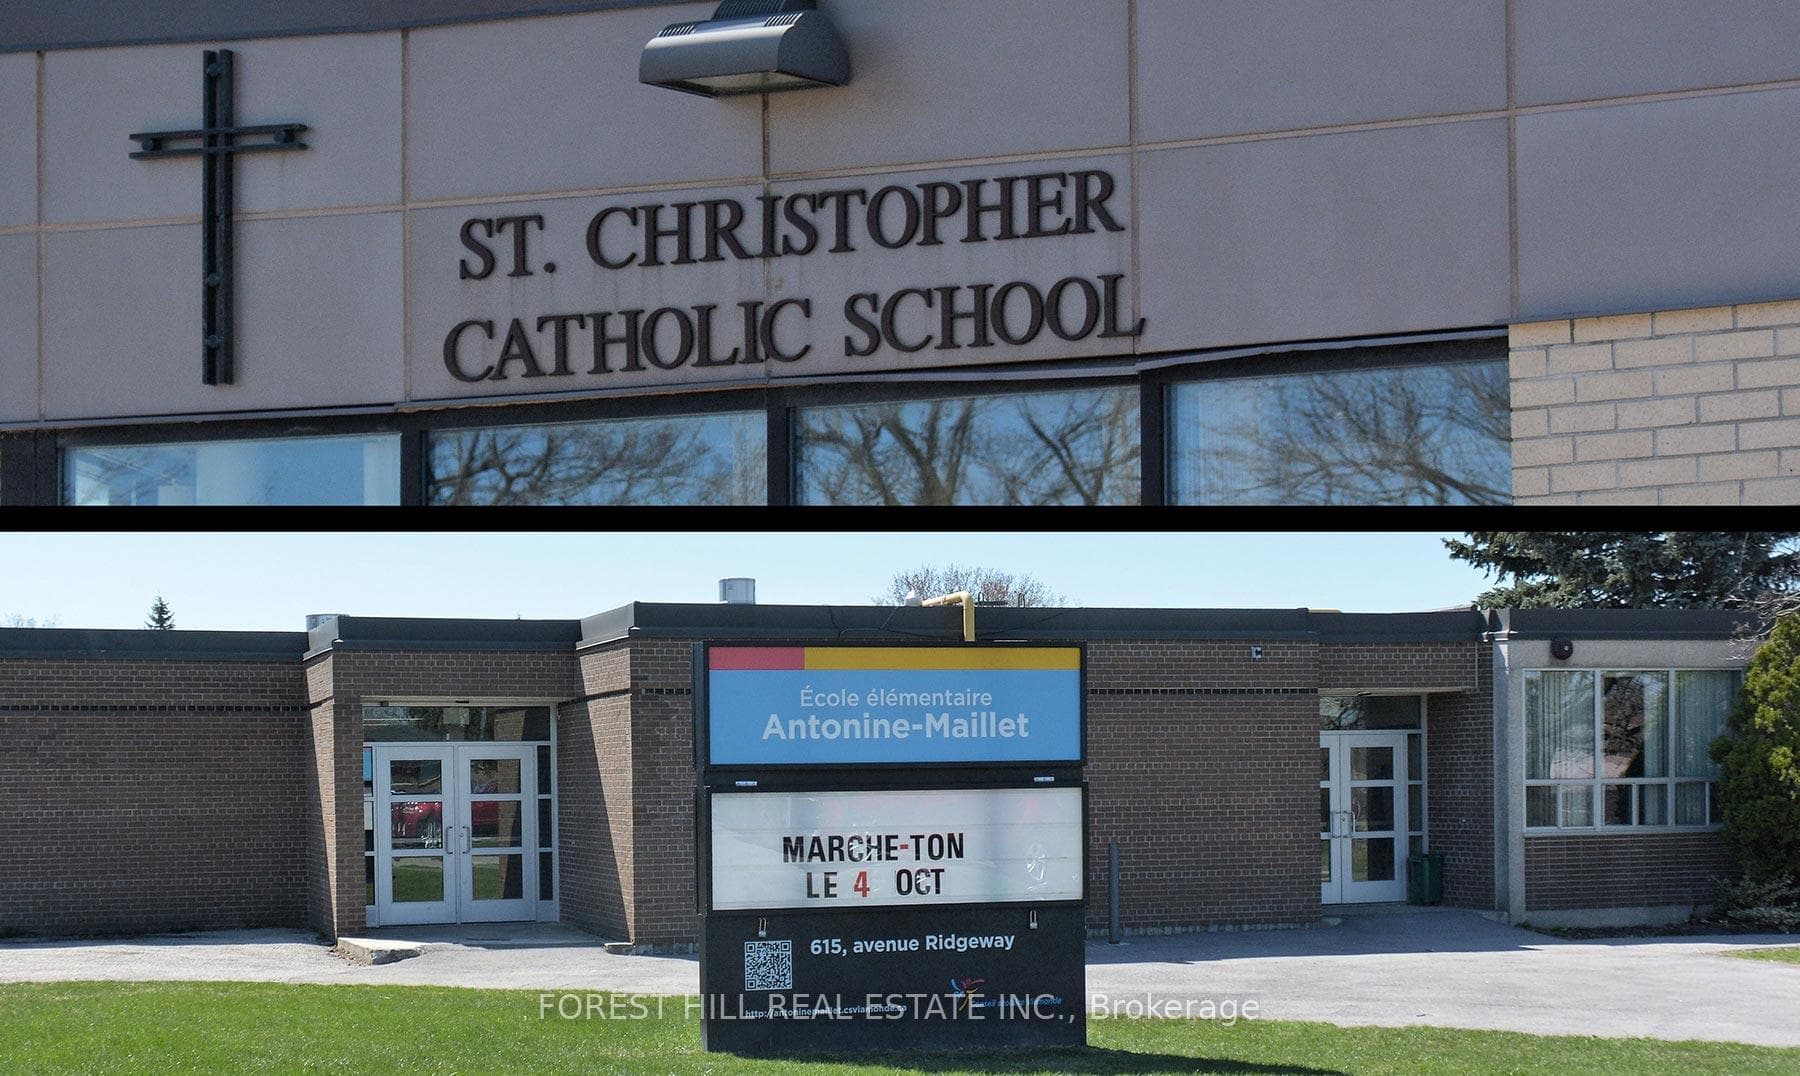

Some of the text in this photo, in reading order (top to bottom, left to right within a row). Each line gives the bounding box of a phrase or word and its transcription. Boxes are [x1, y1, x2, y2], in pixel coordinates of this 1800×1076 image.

[459, 170, 1125, 281] ST. CHRISTOPHER
[443, 274, 1146, 383] CATHOLIC SCHOOL
[800, 685, 992, 707] École élémentaire
[762, 711, 1029, 740] Antonine-Maillet
[782, 832, 964, 863] MARCHE-TON
[806, 868, 945, 898] LE 4 OCT
[810, 934, 1015, 957] 615, avenue Ridgeway
